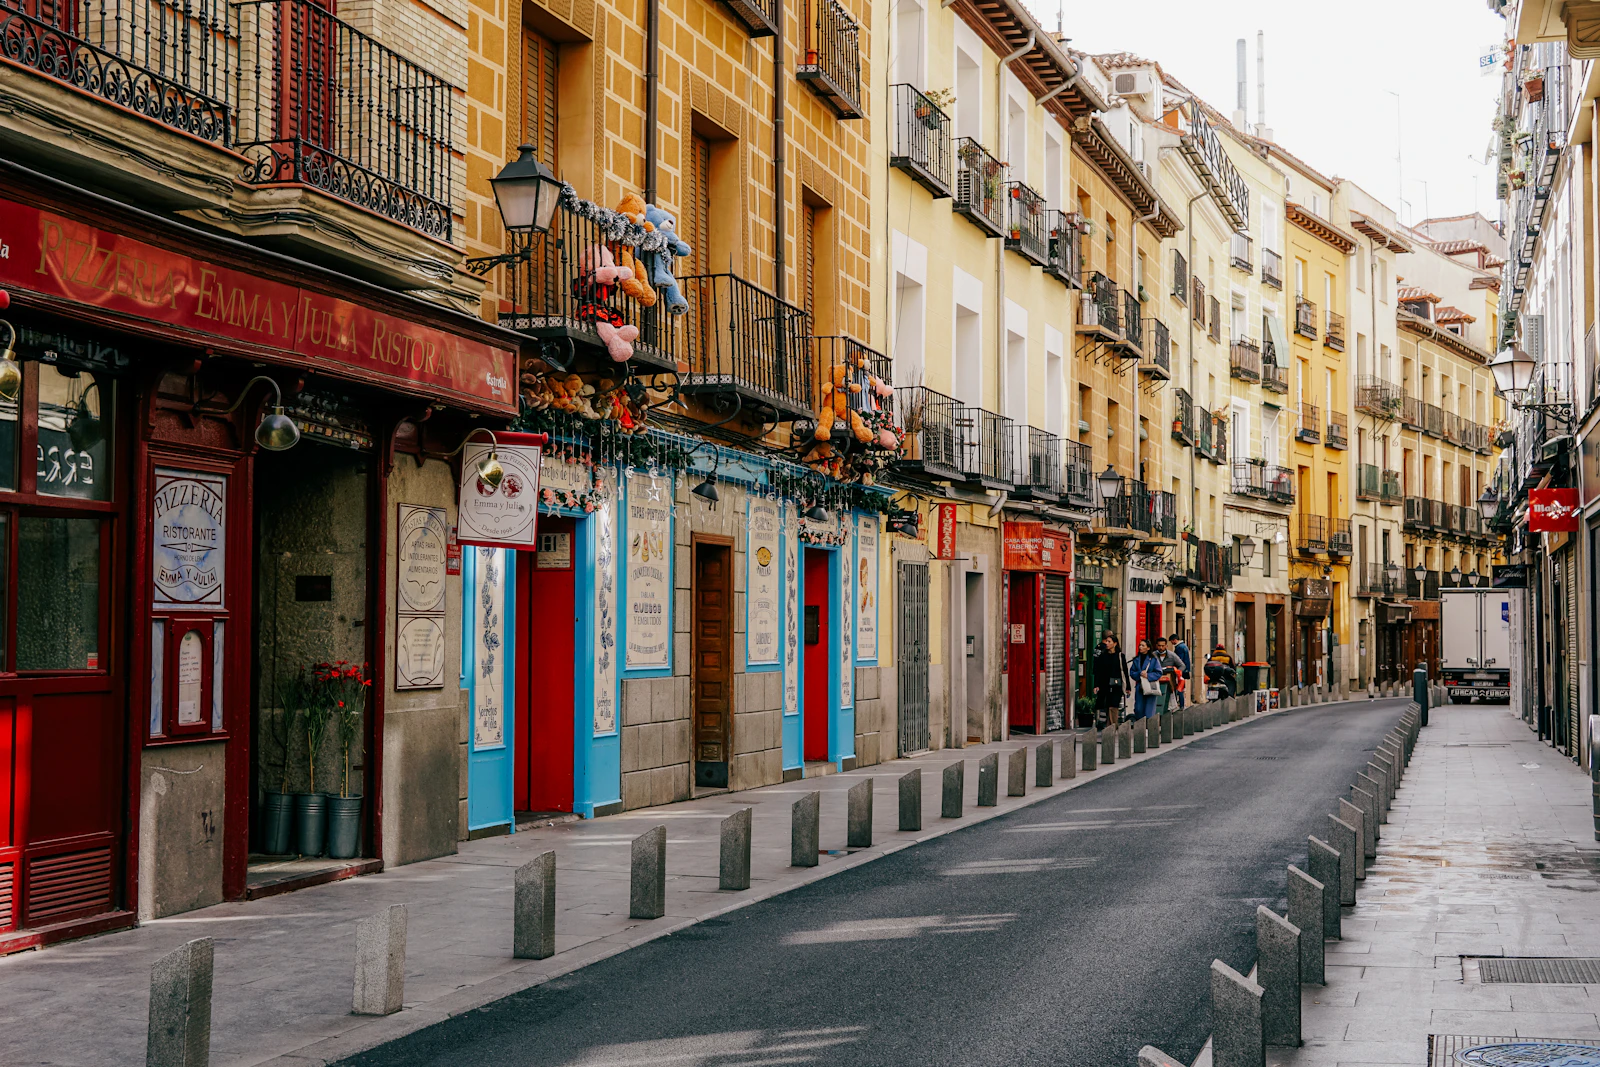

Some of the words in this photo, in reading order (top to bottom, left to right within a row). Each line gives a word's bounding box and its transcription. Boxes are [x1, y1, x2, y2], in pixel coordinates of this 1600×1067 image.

[35, 219, 177, 310] PIZZERIA
[195, 267, 275, 336] EMMA
[281, 301, 296, 339] Y
[298, 296, 358, 355] JULIA
[370, 318, 480, 385] RISTORANTE
[486, 372, 506, 389] Estrella
[154, 484, 223, 527] PIZZERIA
[474, 499, 498, 509] Emma
[500, 503, 504, 511] y
[506, 501, 525, 512] Julia
[163, 525, 217, 541] RISTORANTE
[481, 525, 500, 535] Desde
[501, 526, 513, 535] 1998
[408, 553, 438, 562] INTOLERANTES
[160, 570, 183, 584] EMMA
[186, 568, 191, 579] Y
[194, 572, 216, 586] JULIA
[633, 603, 662, 613] QUESOS
